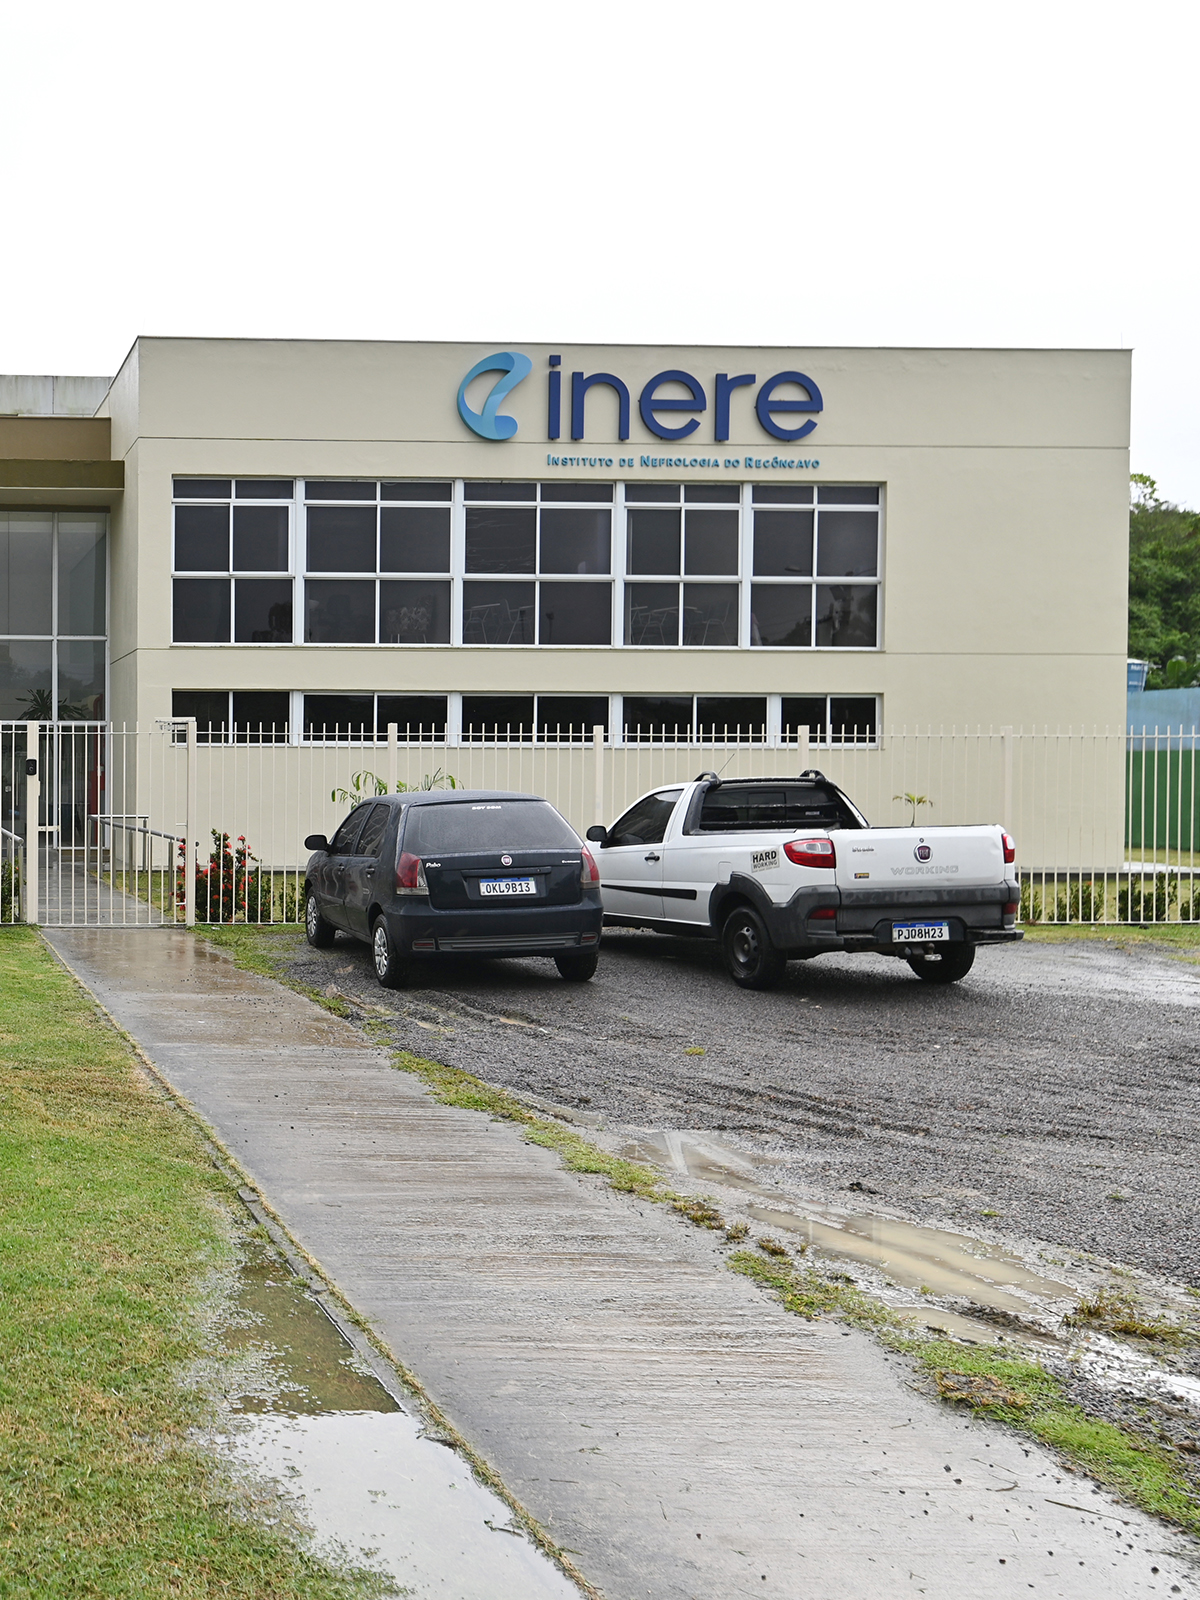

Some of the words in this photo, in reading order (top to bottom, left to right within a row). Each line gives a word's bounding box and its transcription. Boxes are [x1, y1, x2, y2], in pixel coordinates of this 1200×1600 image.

[547, 355, 824, 442] inere
[752, 850, 777, 864] HARD
[753, 860, 778, 870] WORKING
[890, 865, 959, 875] WORKING
